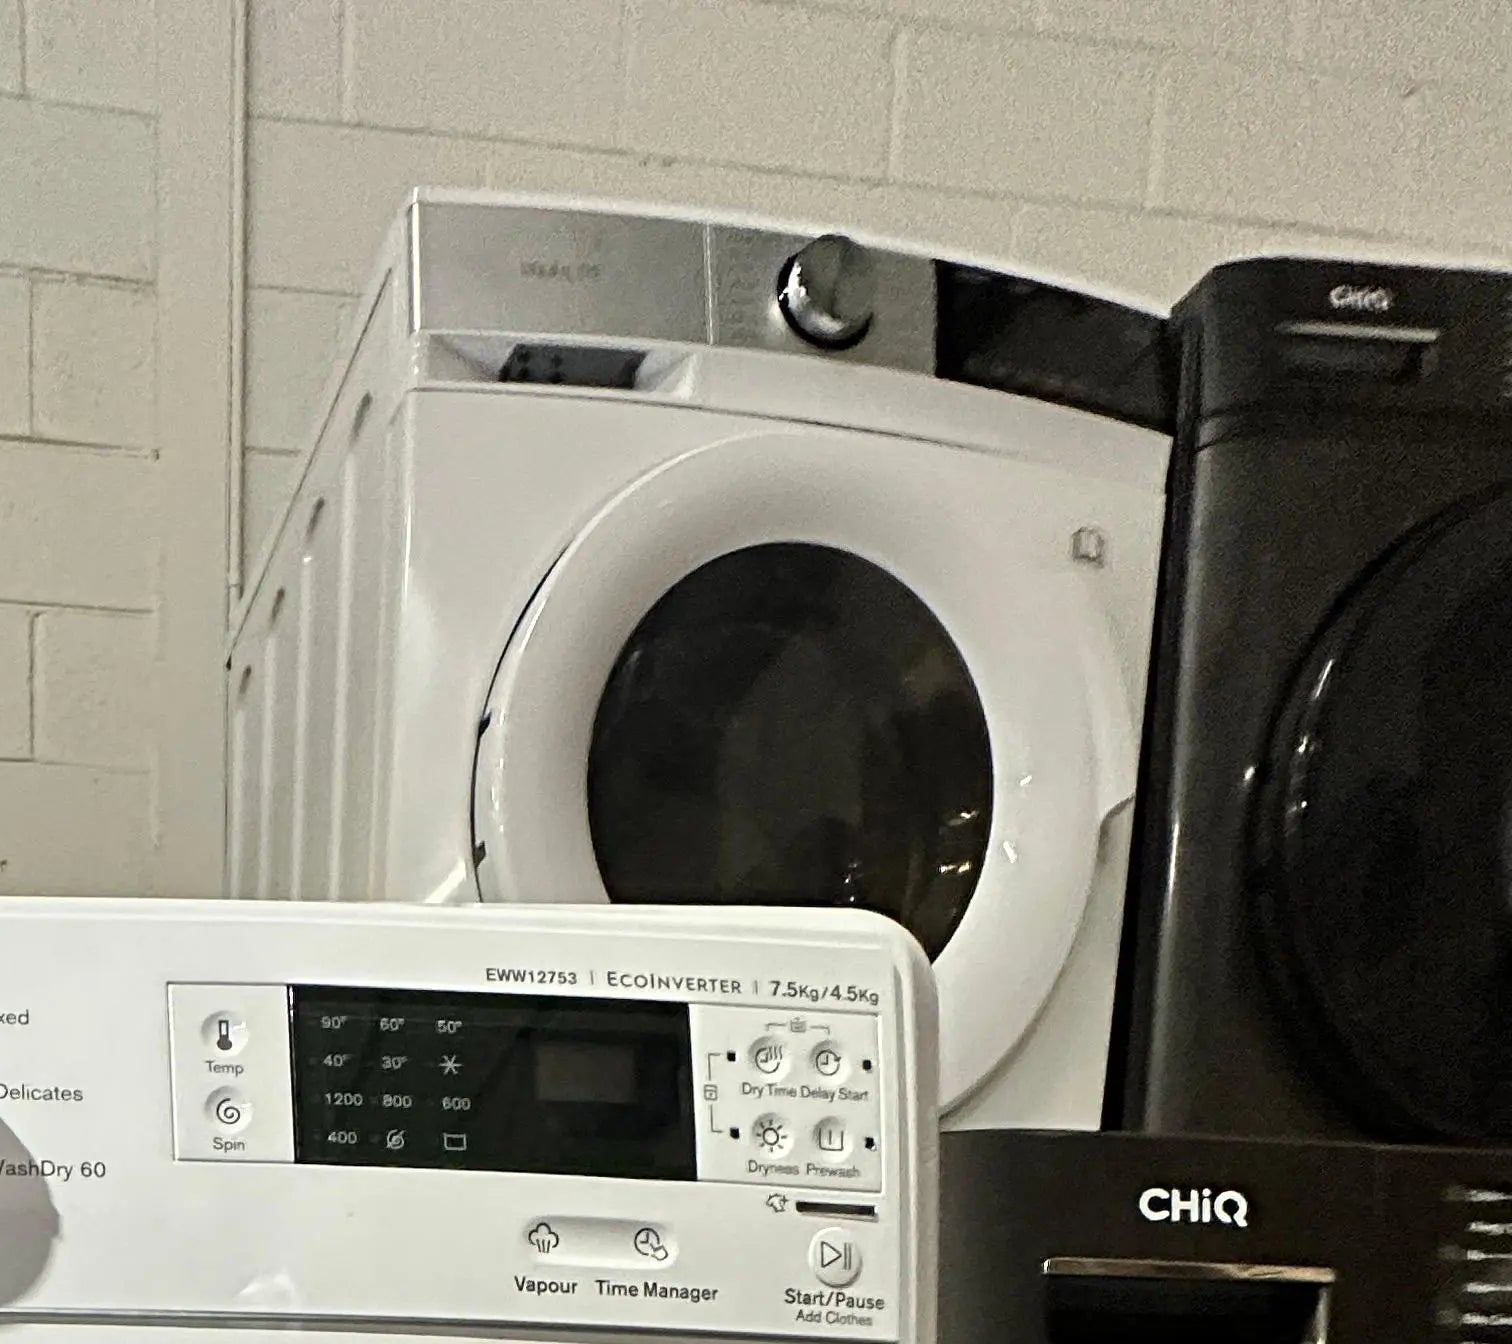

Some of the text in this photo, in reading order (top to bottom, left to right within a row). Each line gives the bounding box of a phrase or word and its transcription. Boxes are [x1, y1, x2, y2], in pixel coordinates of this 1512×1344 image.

[486, 968, 577, 985] EWW12753
[206, 1060, 244, 1075] Temp
[742, 1083, 797, 1098] Dry Time
[801, 1086, 869, 1102] Delay Start
[325, 1093, 363, 1106] 1200
[213, 1137, 245, 1154] Spin
[328, 1131, 357, 1145] 400
[80, 1161, 107, 1178] 60
[1139, 1187, 1248, 1227] CHiQ
[515, 1276, 578, 1297] Vapour
[595, 1280, 718, 1301] Time Manager
[785, 1288, 885, 1310] Start/Pause
[796, 1310, 872, 1327] Add Clothes
